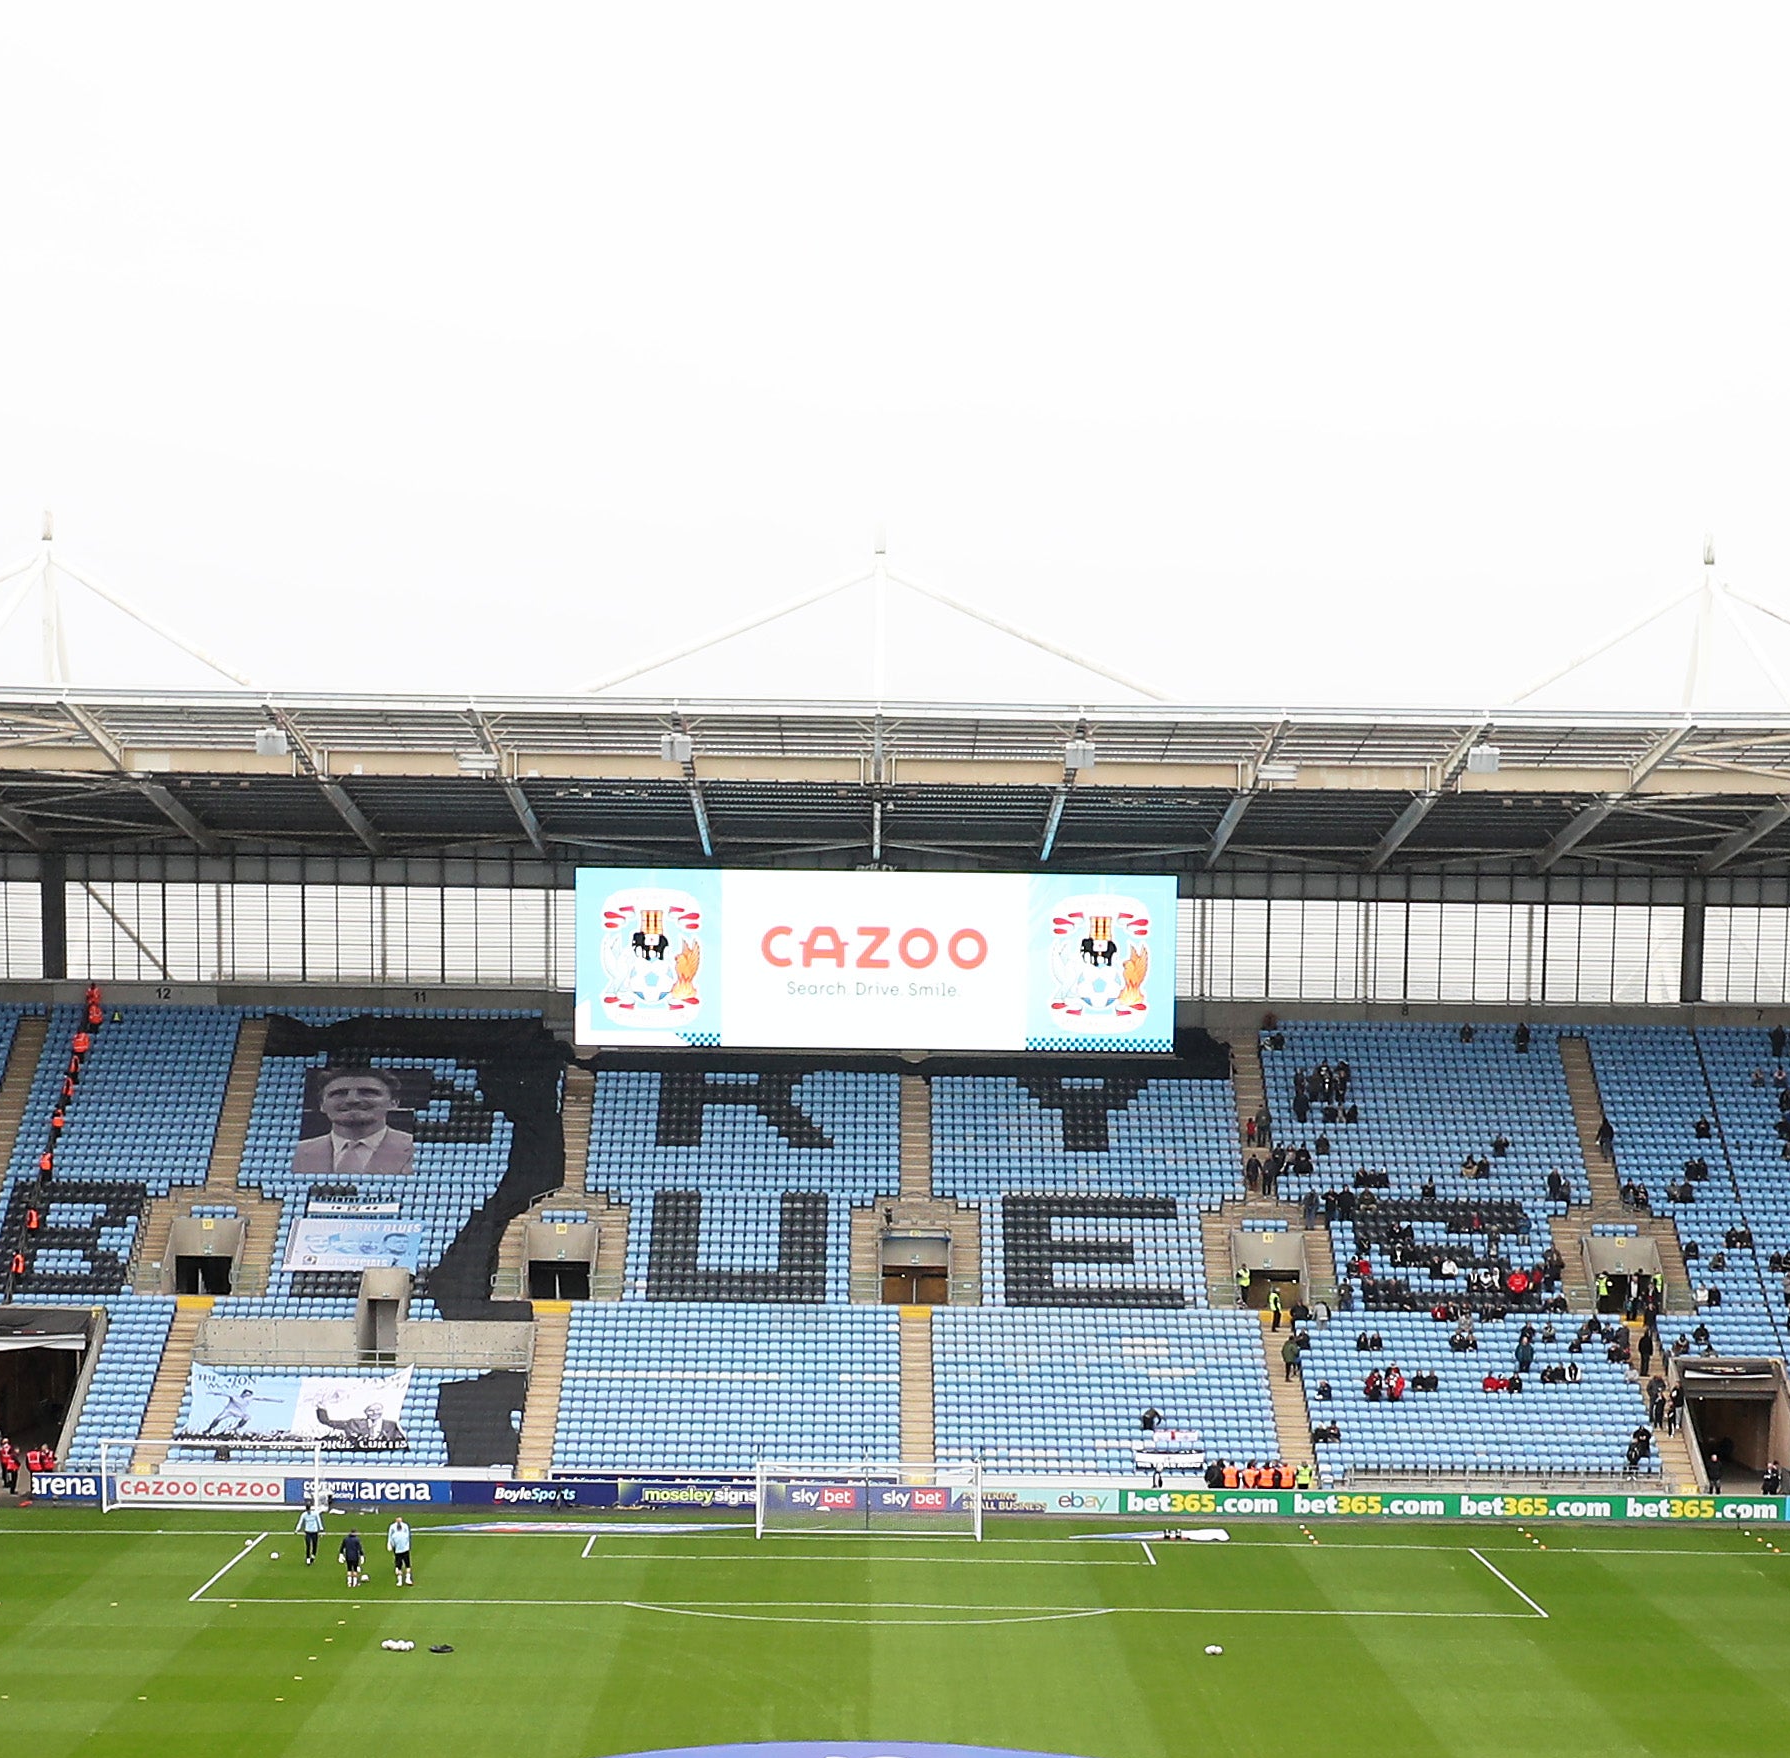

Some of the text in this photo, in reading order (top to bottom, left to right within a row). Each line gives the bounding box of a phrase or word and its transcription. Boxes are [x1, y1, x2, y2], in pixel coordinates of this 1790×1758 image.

[761, 925, 989, 969] CAZOO
[32, 1477, 96, 1496] arena
[120, 1481, 198, 1496] CAZOO
[204, 1482, 280, 1498] CAZOO
[361, 1482, 431, 1501] arena
[792, 1488, 851, 1506] sky bet
[882, 1490, 942, 1508] sky bet
[1058, 1491, 1109, 1511] ebay
[1127, 1491, 1278, 1513] bet365.com
[1294, 1494, 1444, 1515] bet365.com
[1460, 1496, 1611, 1517] bet365.com
[1626, 1498, 1777, 1519] bet365.com
